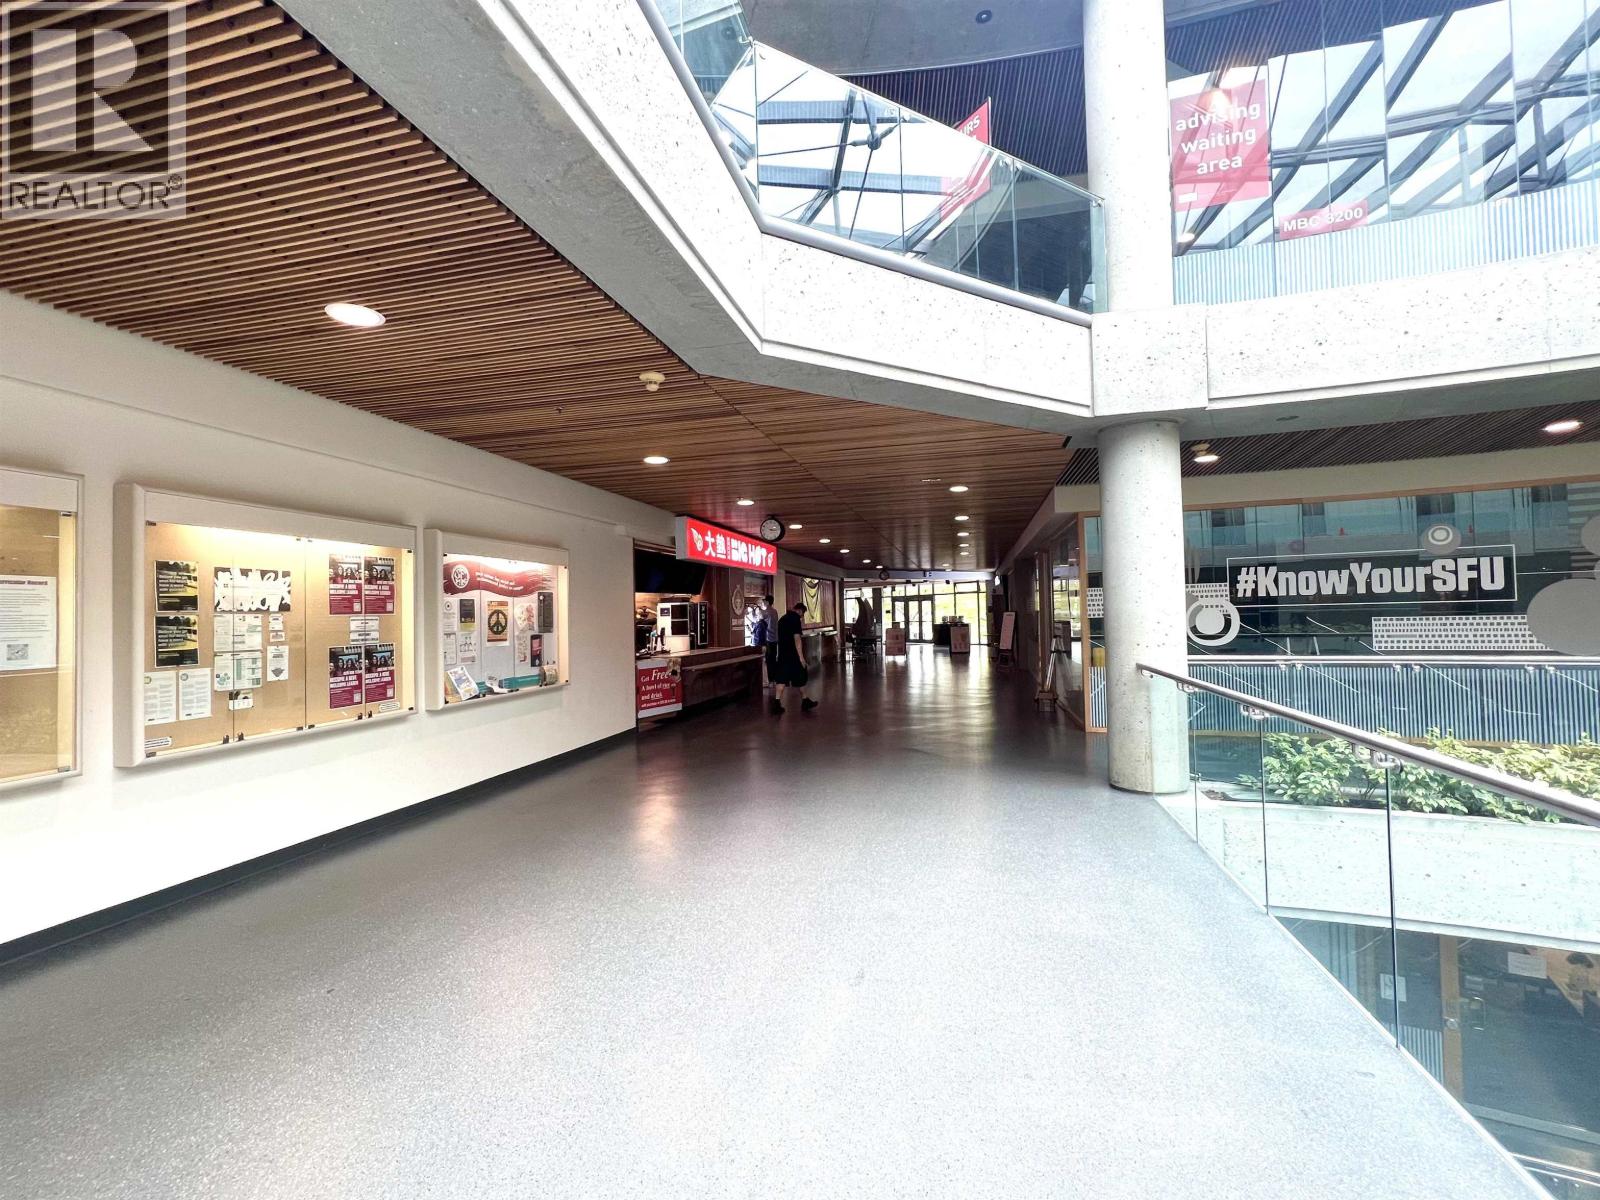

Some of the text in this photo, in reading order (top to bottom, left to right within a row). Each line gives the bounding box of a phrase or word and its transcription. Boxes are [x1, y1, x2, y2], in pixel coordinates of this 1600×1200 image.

[1175, 101, 1261, 132] advising
[1181, 128, 1257, 154] waiting
[1196, 155, 1243, 175] area
[1283, 215, 1322, 232] MBC
[731, 538, 748, 563] BIG
[748, 543, 767, 567] HOT
[1236, 556, 1504, 598] #KnowYourSFU
[651, 669, 669, 681] Free
